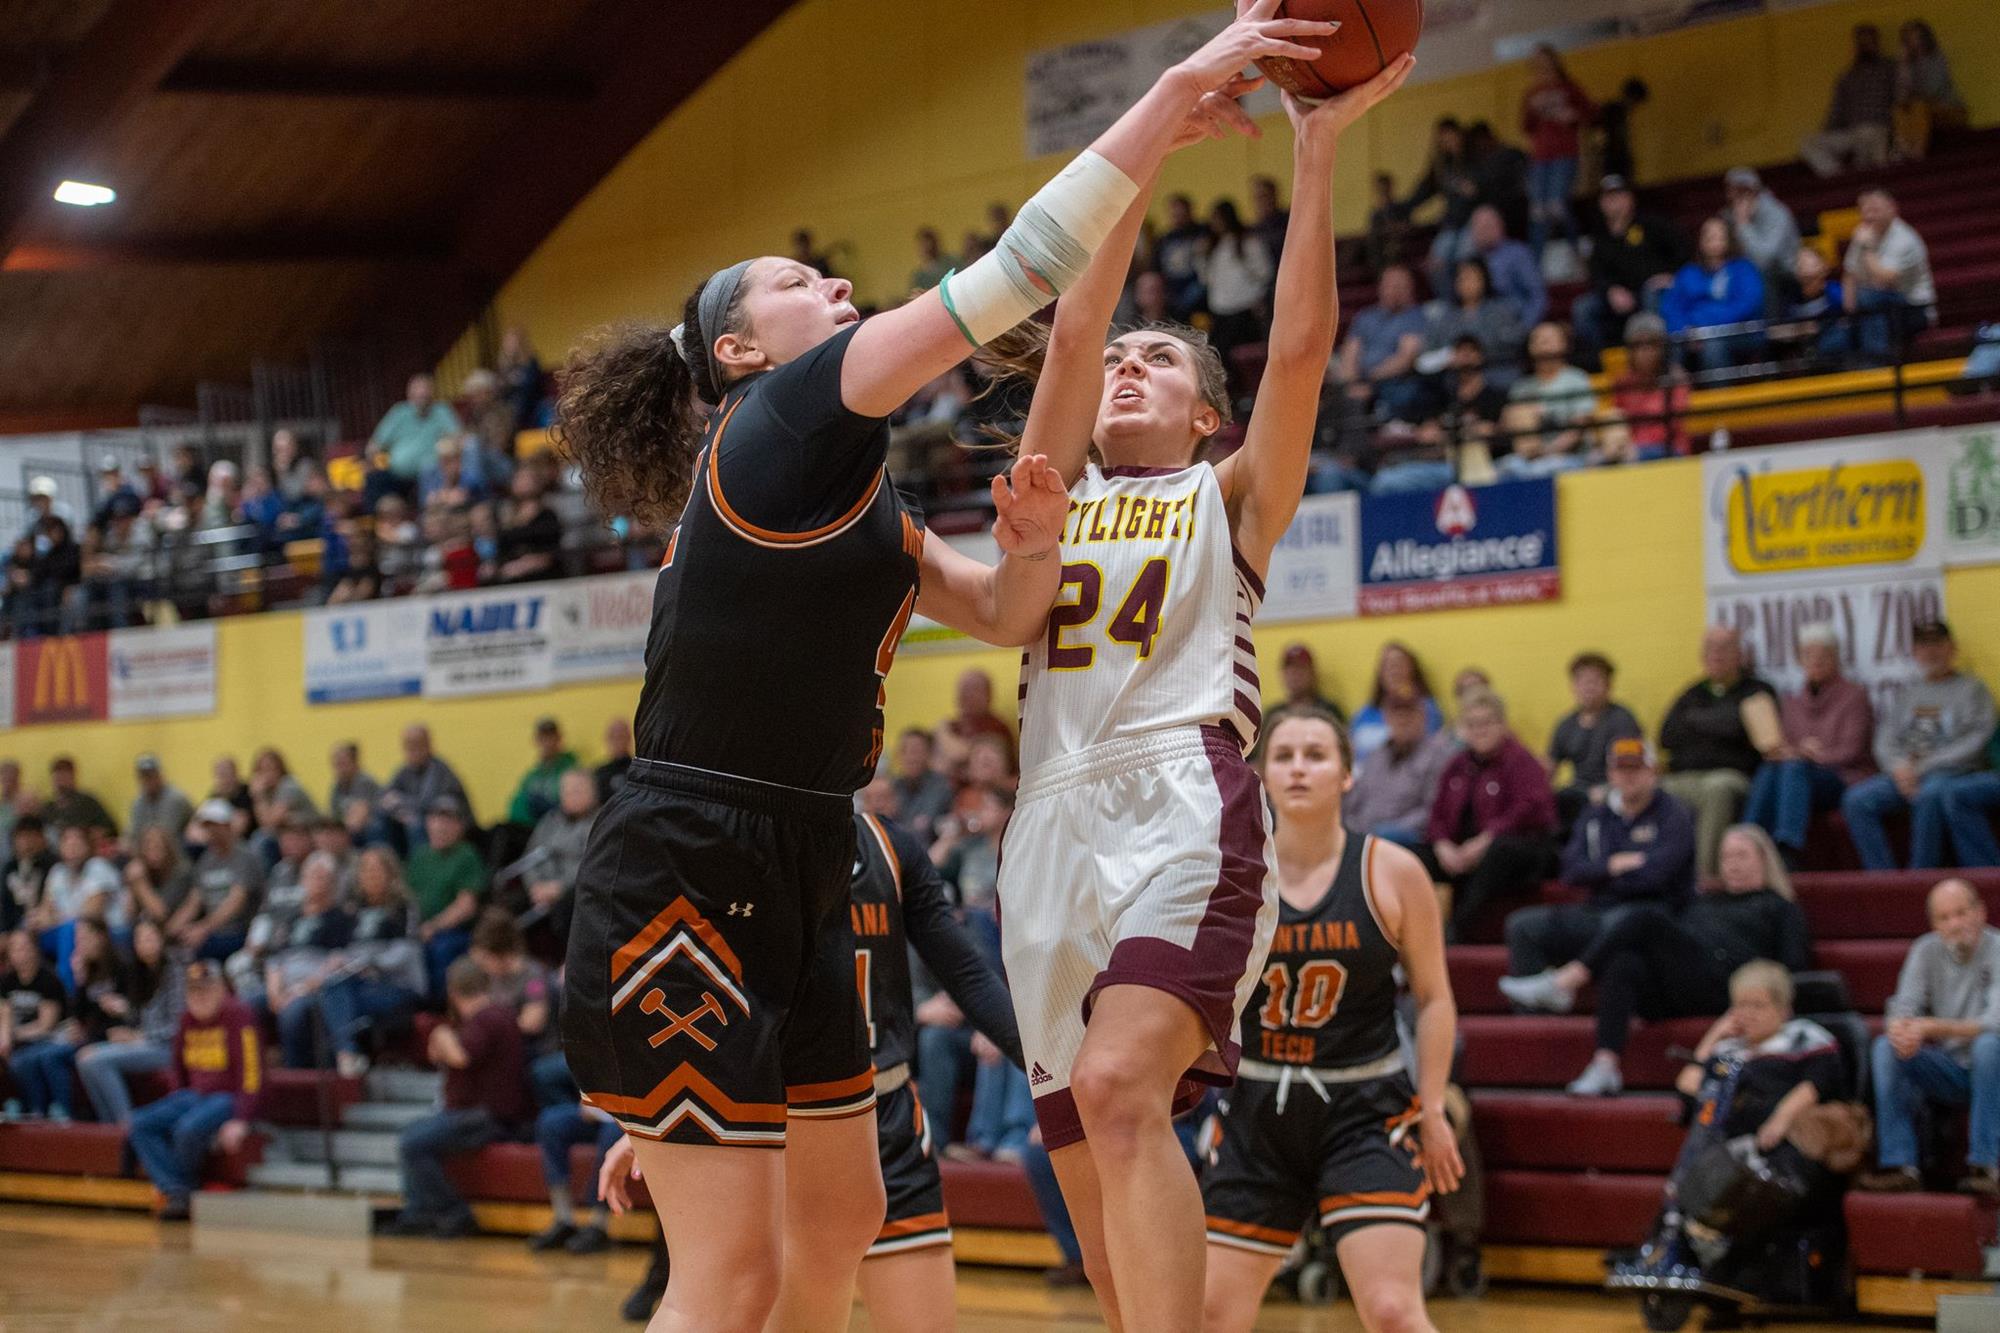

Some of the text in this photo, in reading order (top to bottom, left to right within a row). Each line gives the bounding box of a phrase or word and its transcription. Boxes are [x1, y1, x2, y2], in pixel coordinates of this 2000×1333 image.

[1056, 487, 1198, 544] YLIGHT
[1369, 532, 1545, 581] Allegiance
[428, 597, 545, 637] NAULT
[1048, 555, 1172, 672] 24
[1271, 921, 1360, 952] NTANA
[1260, 959, 1348, 1029] 10
[1262, 1030, 1316, 1062] TECH
